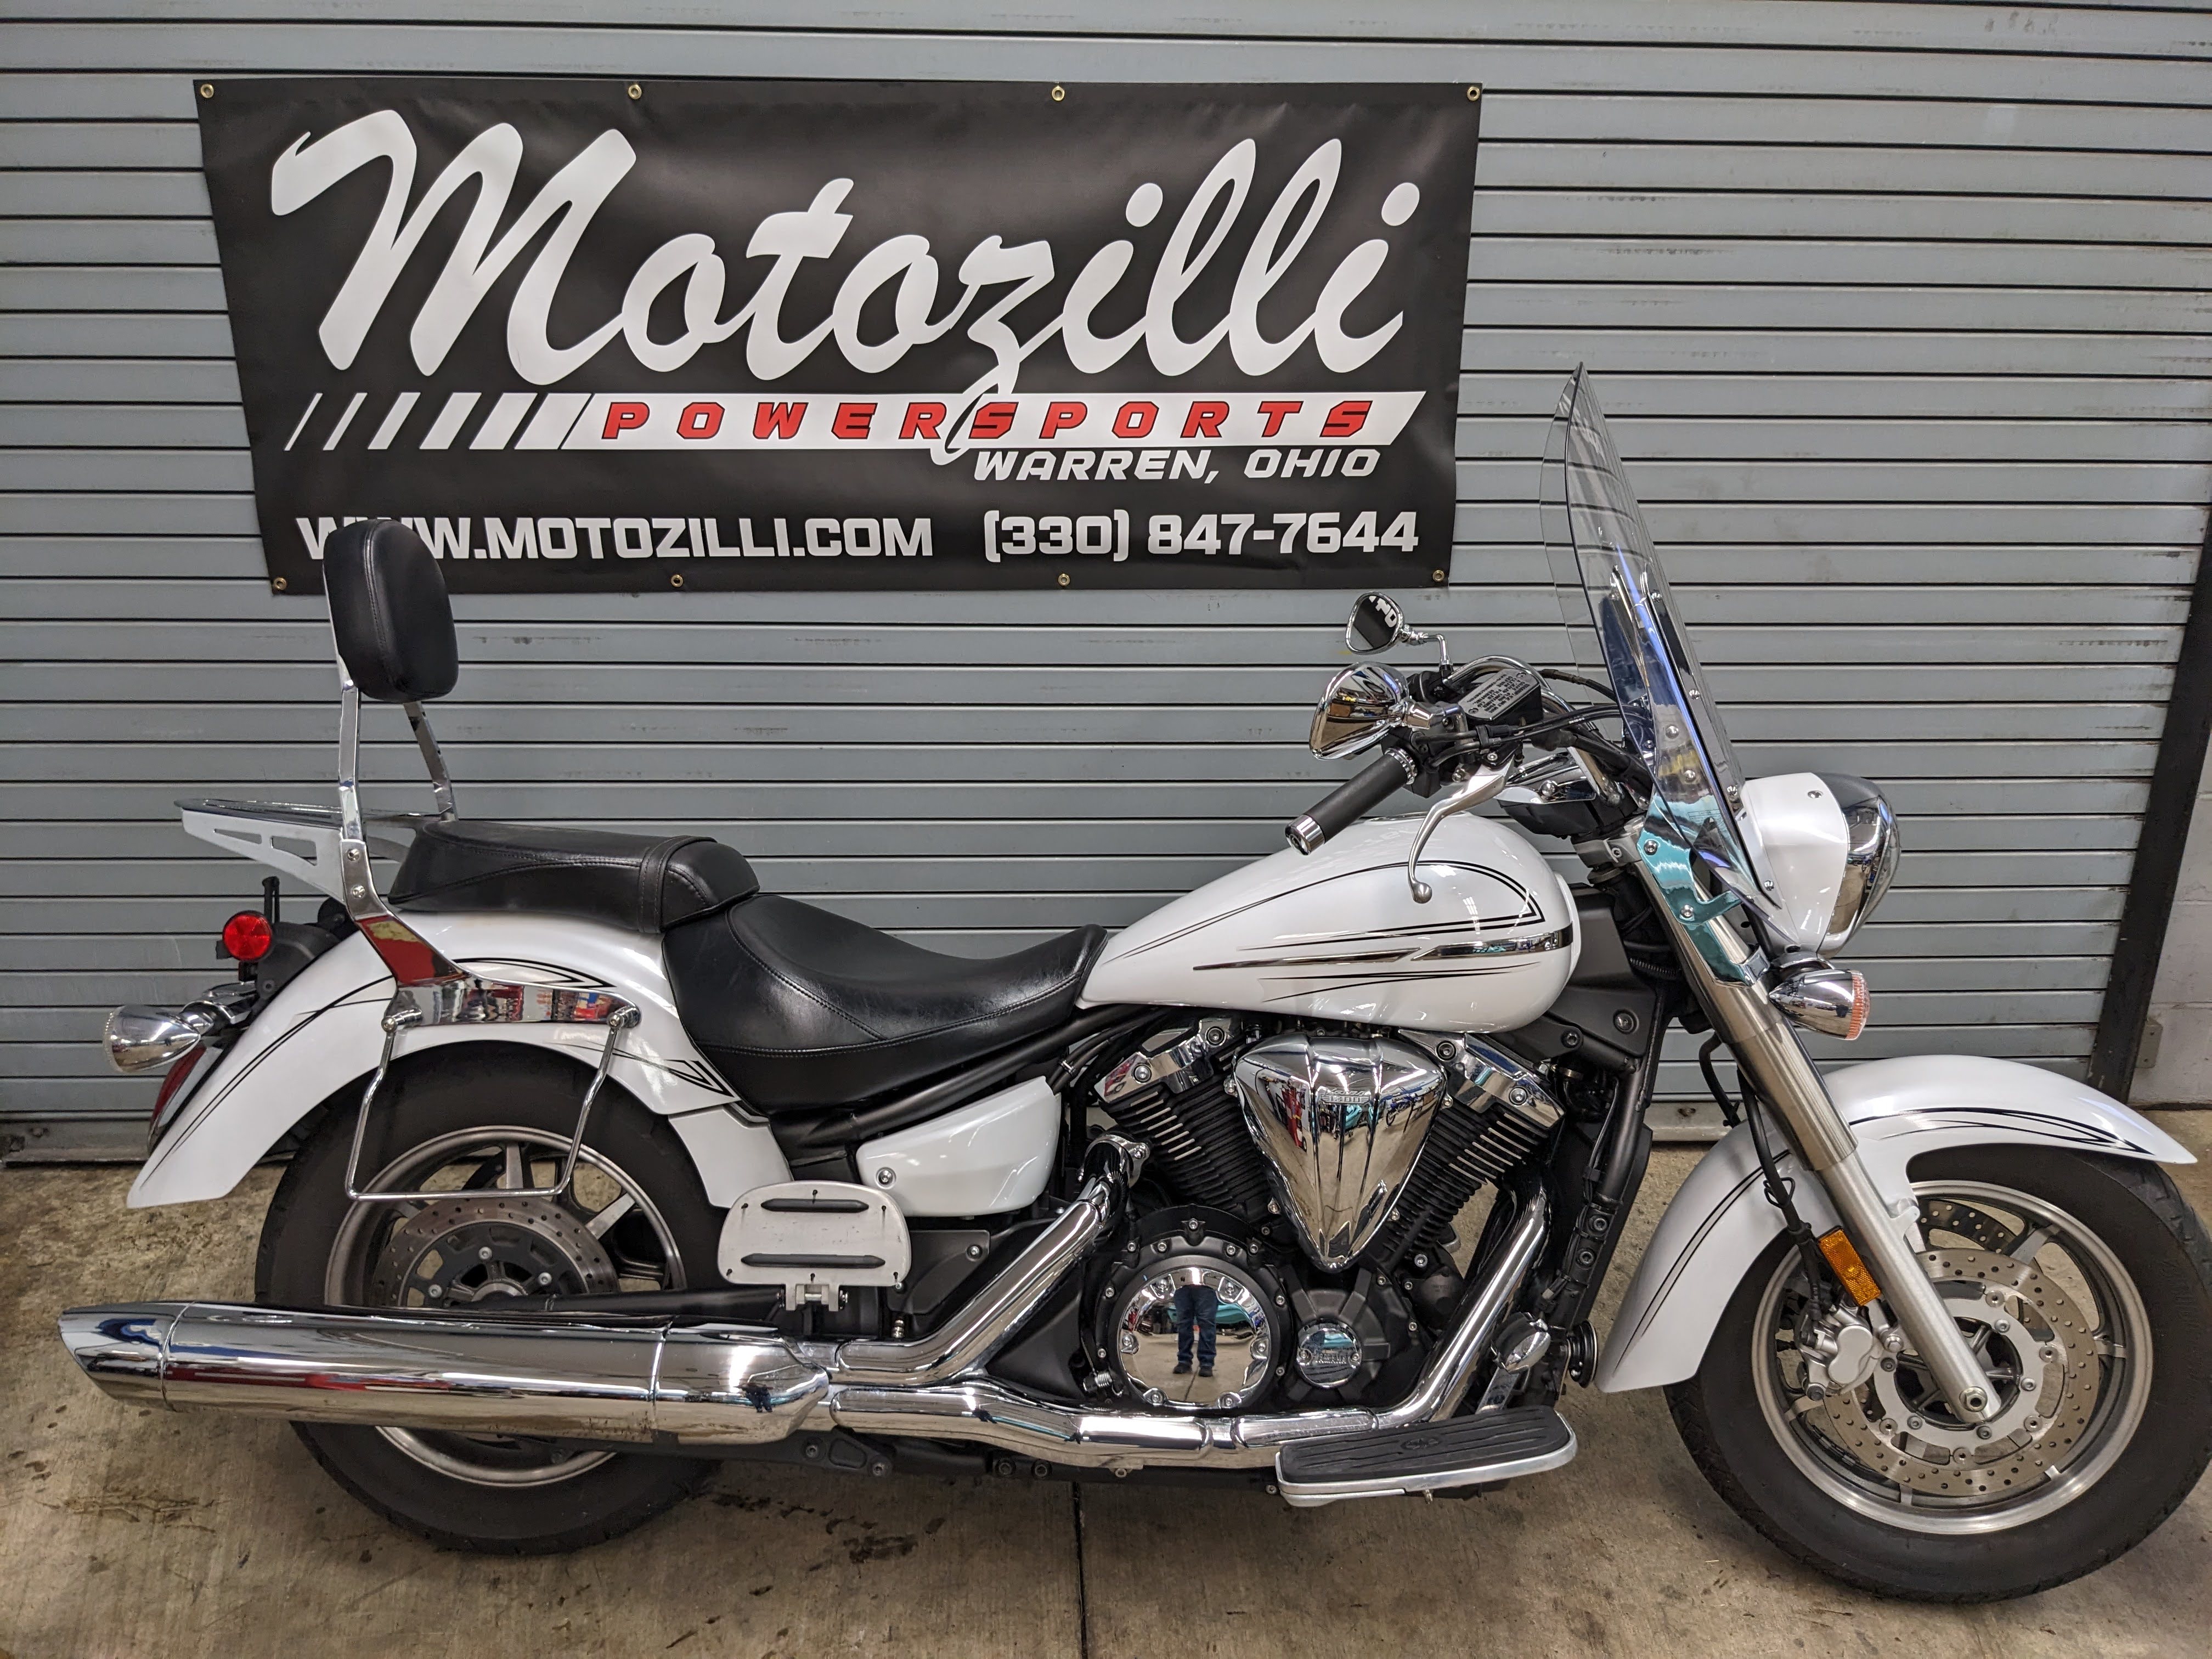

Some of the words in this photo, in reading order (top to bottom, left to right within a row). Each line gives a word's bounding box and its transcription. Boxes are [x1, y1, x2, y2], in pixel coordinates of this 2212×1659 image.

[272, 110, 1419, 465] Motozilli
[602, 401, 1372, 439] POWERSPORTS
[974, 450, 1218, 484] WARREN,
[1244, 449, 1381, 478] OHIO
[296, 517, 933, 559] WW.MOTOZILLI.COM
[984, 510, 1130, 562] (330)
[1148, 511, 1419, 555] 847-7644
